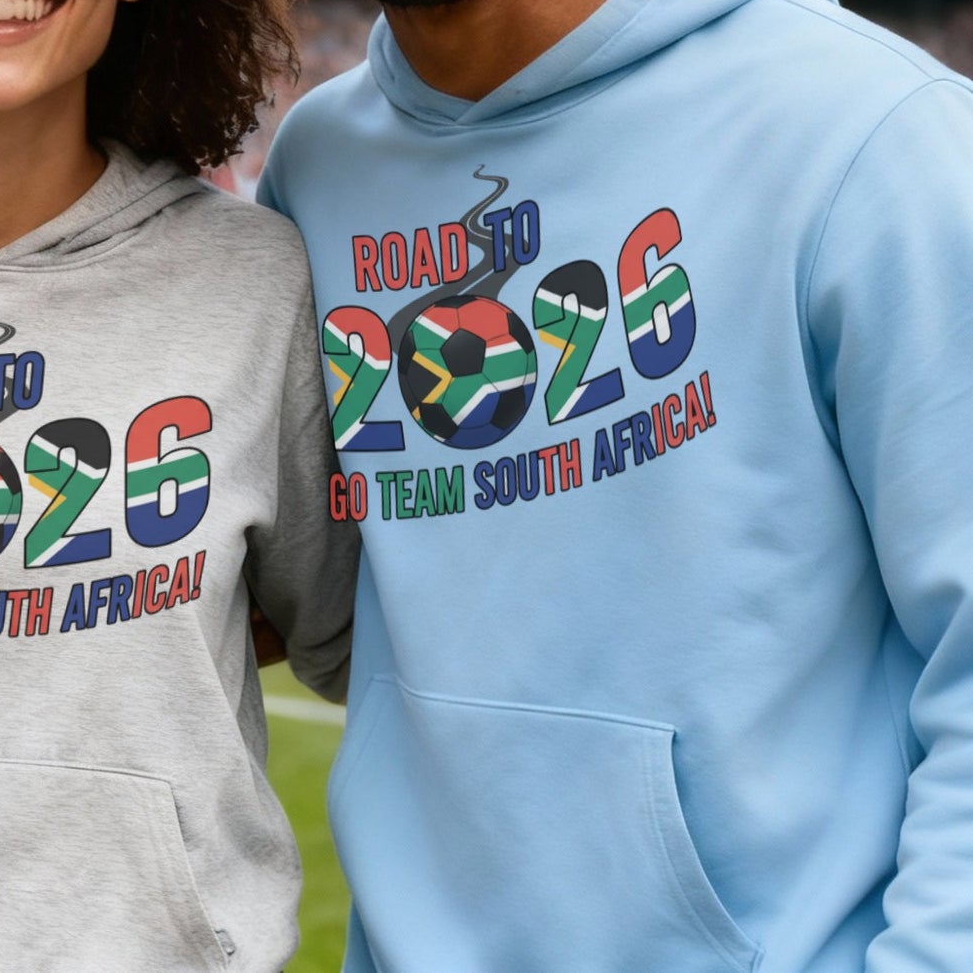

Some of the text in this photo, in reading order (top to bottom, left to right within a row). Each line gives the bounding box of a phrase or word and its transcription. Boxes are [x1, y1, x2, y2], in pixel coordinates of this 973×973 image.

[352, 199, 541, 292] ROAD TO
[329, 370, 717, 522] GO TEAM SOUTH AFRICA!
[59, 550, 207, 633] AFRICA!
